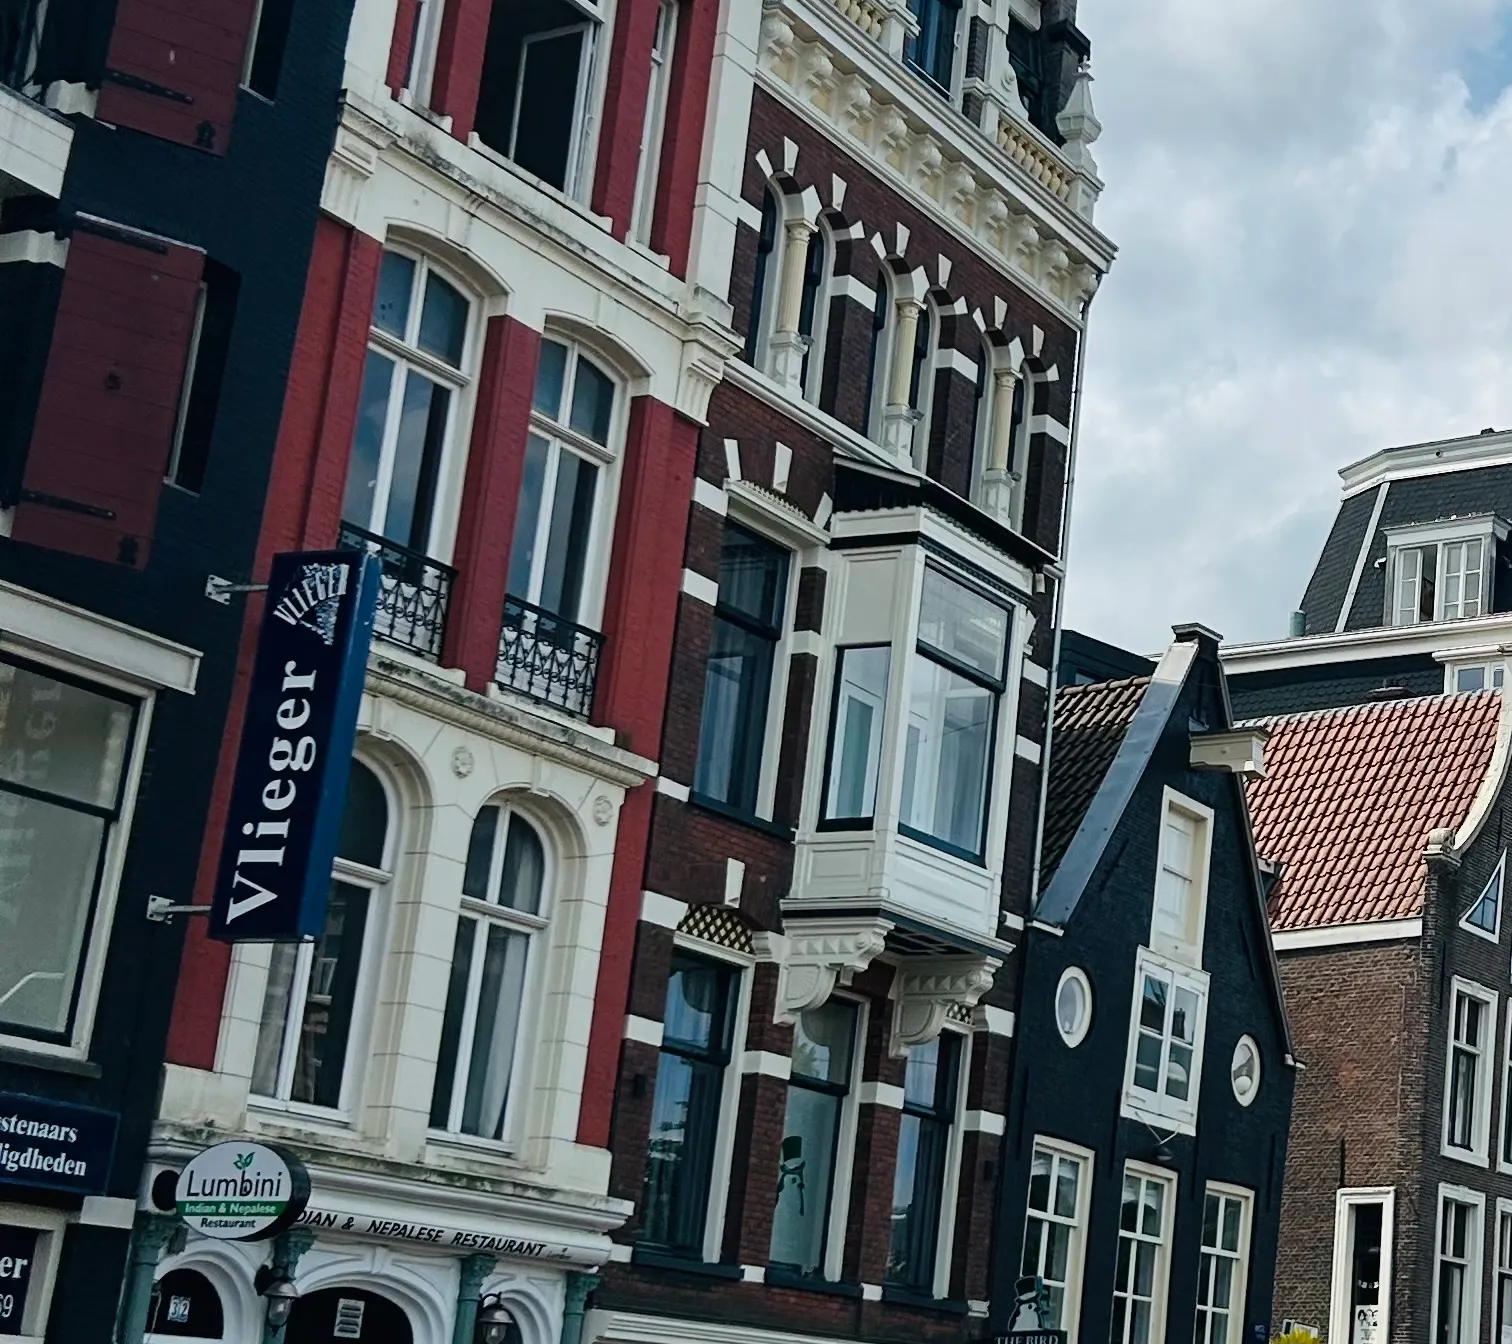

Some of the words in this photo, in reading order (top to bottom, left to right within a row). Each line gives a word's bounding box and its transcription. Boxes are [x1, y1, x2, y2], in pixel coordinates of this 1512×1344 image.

[226, 660, 317, 925] Vlieger
[0, 1113, 79, 1143] stenaars
[186, 1170, 283, 1197] Lumbini
[185, 1202, 215, 1214] Indian
[218, 1203, 227, 1214] &
[229, 1203, 277, 1216] Nepalese
[200, 1218, 256, 1229] Restaurant
[341, 1216, 355, 1230] &
[366, 1220, 444, 1243] NEPALESE
[452, 1231, 547, 1257] RESTAURANT
[169, 1299, 191, 1320] 32
